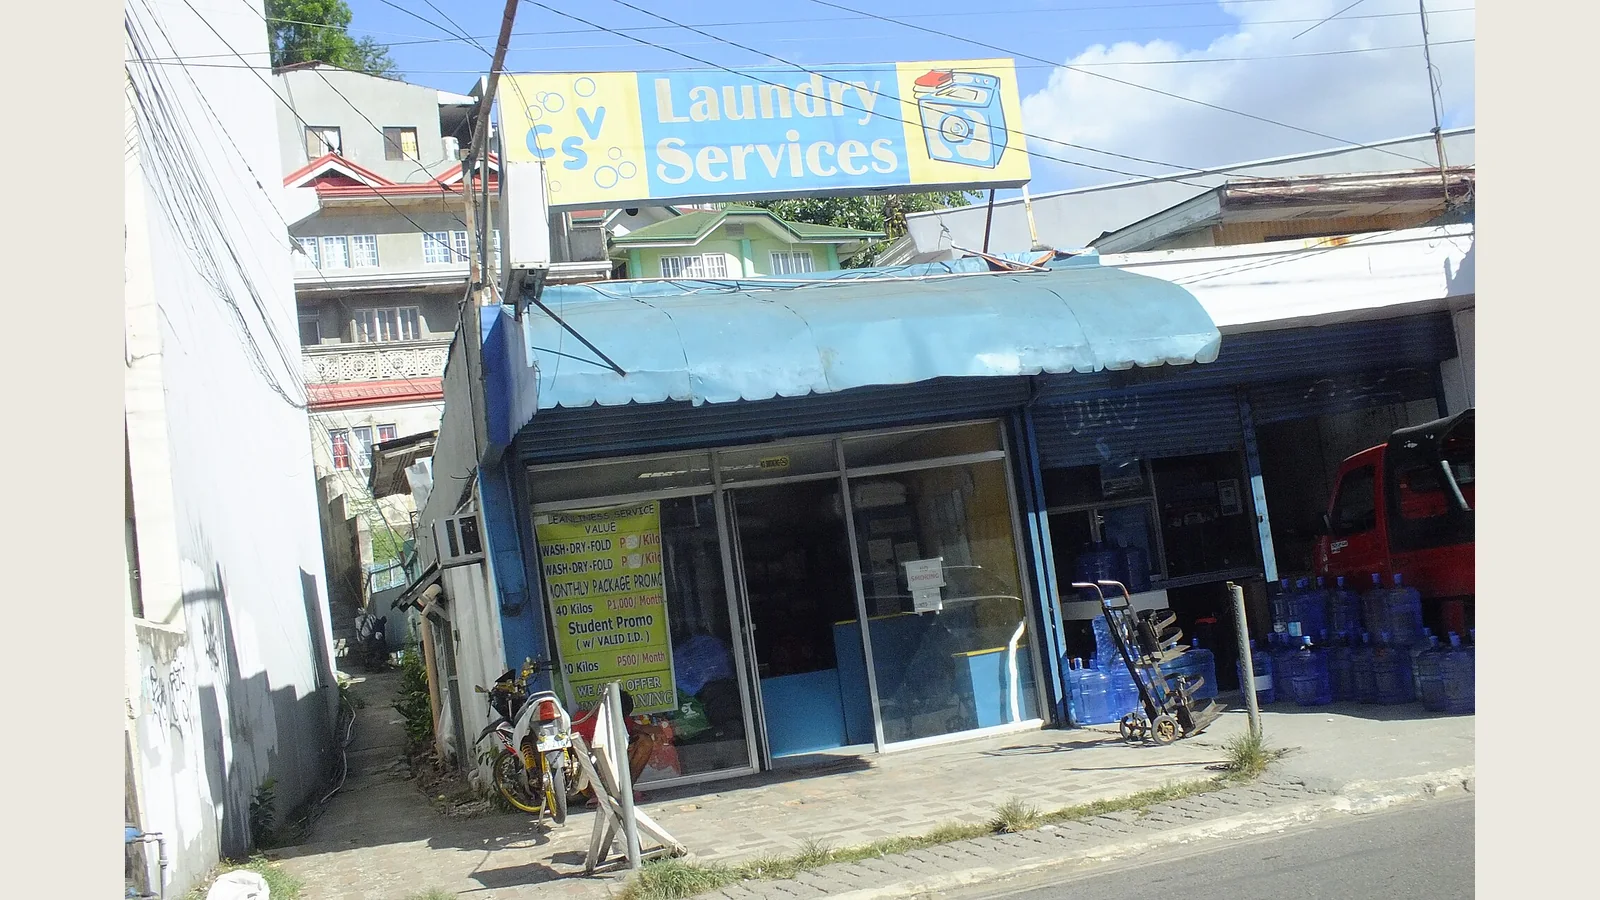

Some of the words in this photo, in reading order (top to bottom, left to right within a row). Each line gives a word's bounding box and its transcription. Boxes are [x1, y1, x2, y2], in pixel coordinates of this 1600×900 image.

[655, 75, 881, 125] Laundry
[656, 130, 898, 185] Services
[547, 511, 609, 524] LEANLINESS
[614, 504, 655, 518] SERVICE
[585, 522, 616, 534] VALUE
[593, 575, 631, 593] PACKAGE
[556, 605, 568, 617] 40
[570, 603, 593, 616] Kilos
[640, 594, 663, 605] Month
[568, 617, 613, 635] Student
[616, 615, 653, 628] Promo
[598, 633, 625, 646] VALID
[576, 661, 599, 674] Kilos
[642, 651, 666, 663] Month
[577, 684, 594, 697] WE
[626, 676, 662, 691] OFFER
